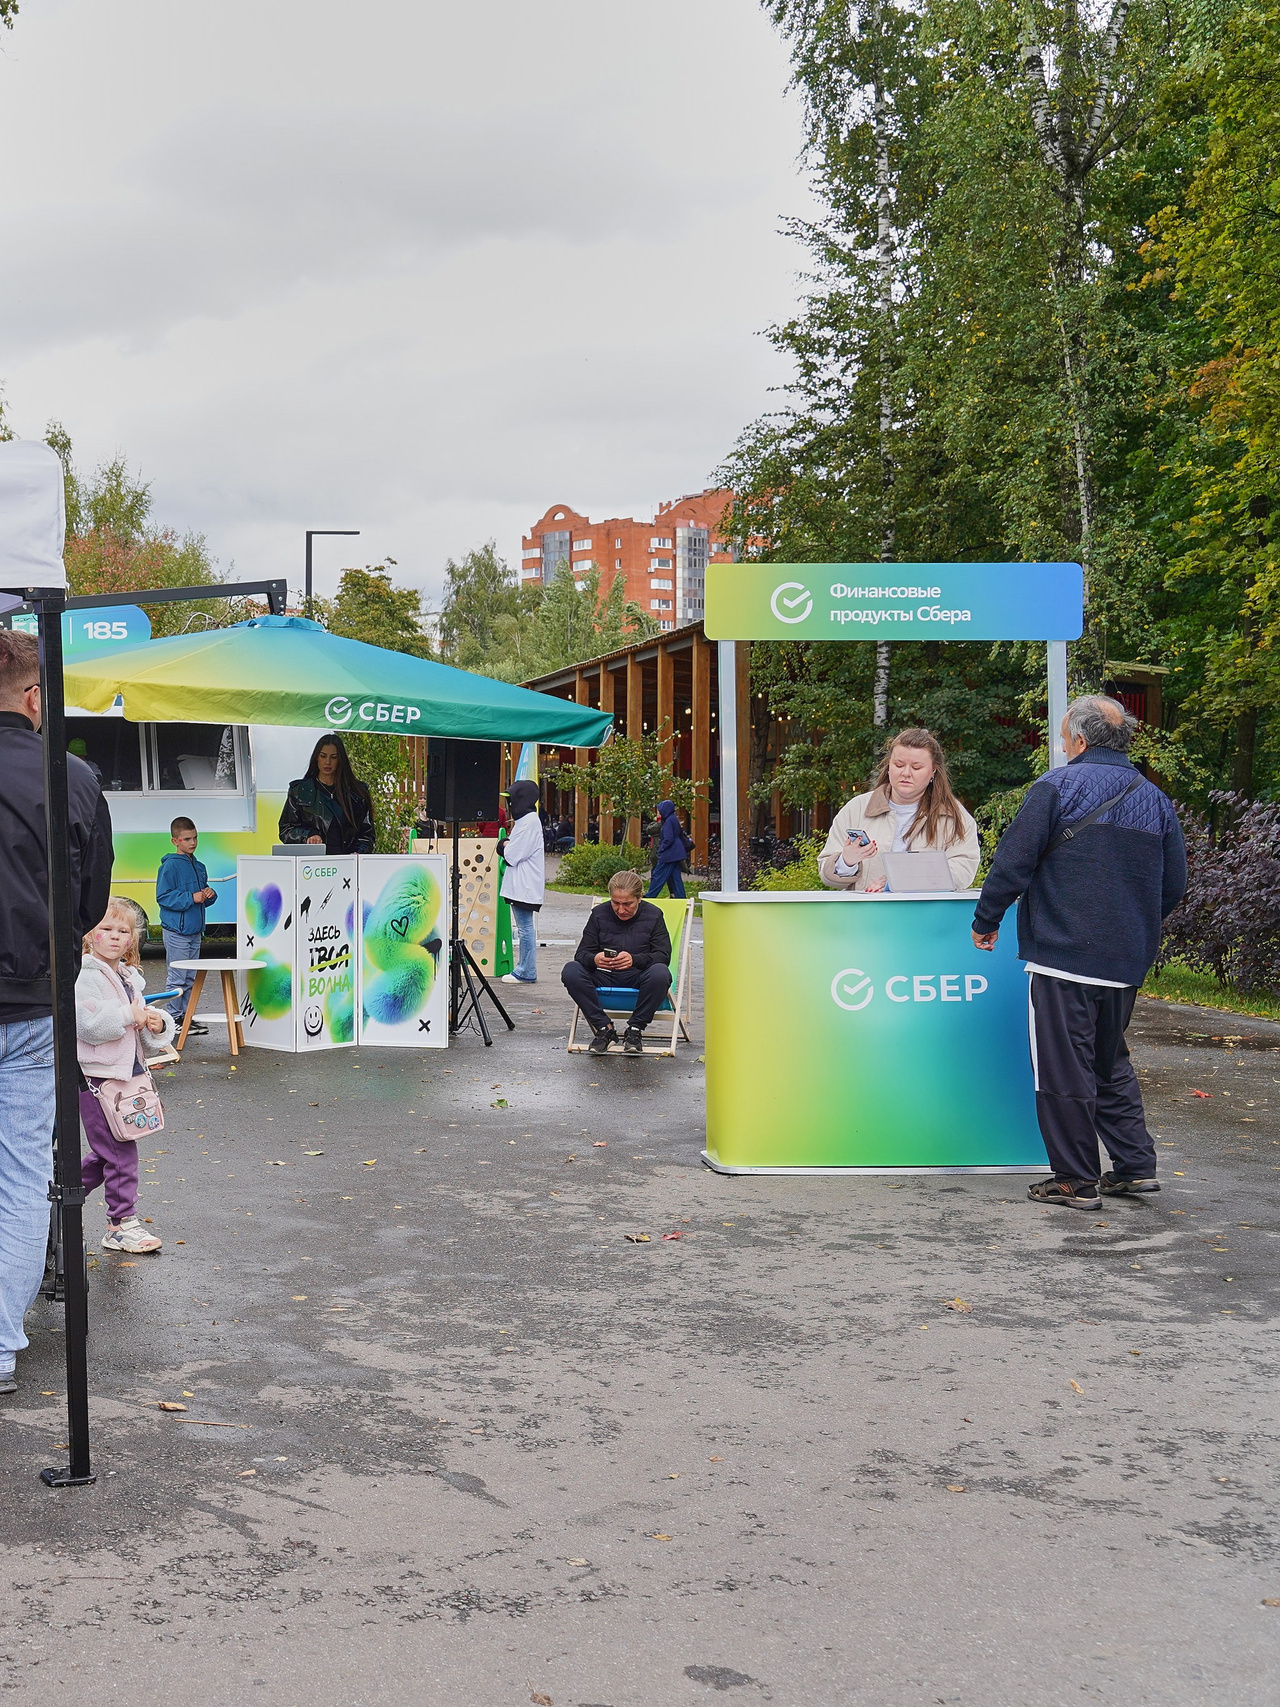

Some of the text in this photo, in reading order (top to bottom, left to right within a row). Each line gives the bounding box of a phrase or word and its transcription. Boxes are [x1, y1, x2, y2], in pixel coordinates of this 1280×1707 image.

[830, 583, 941, 598] Финансовые
[830, 605, 971, 625] продукты Сбера
[82, 621, 128, 640] 185
[358, 702, 421, 724] СБЕР
[314, 867, 338, 877] СБЕР
[307, 925, 341, 943] ЗДЕСЬ
[308, 974, 350, 997] ВОЛНА
[885, 974, 988, 1003] СБЕР
